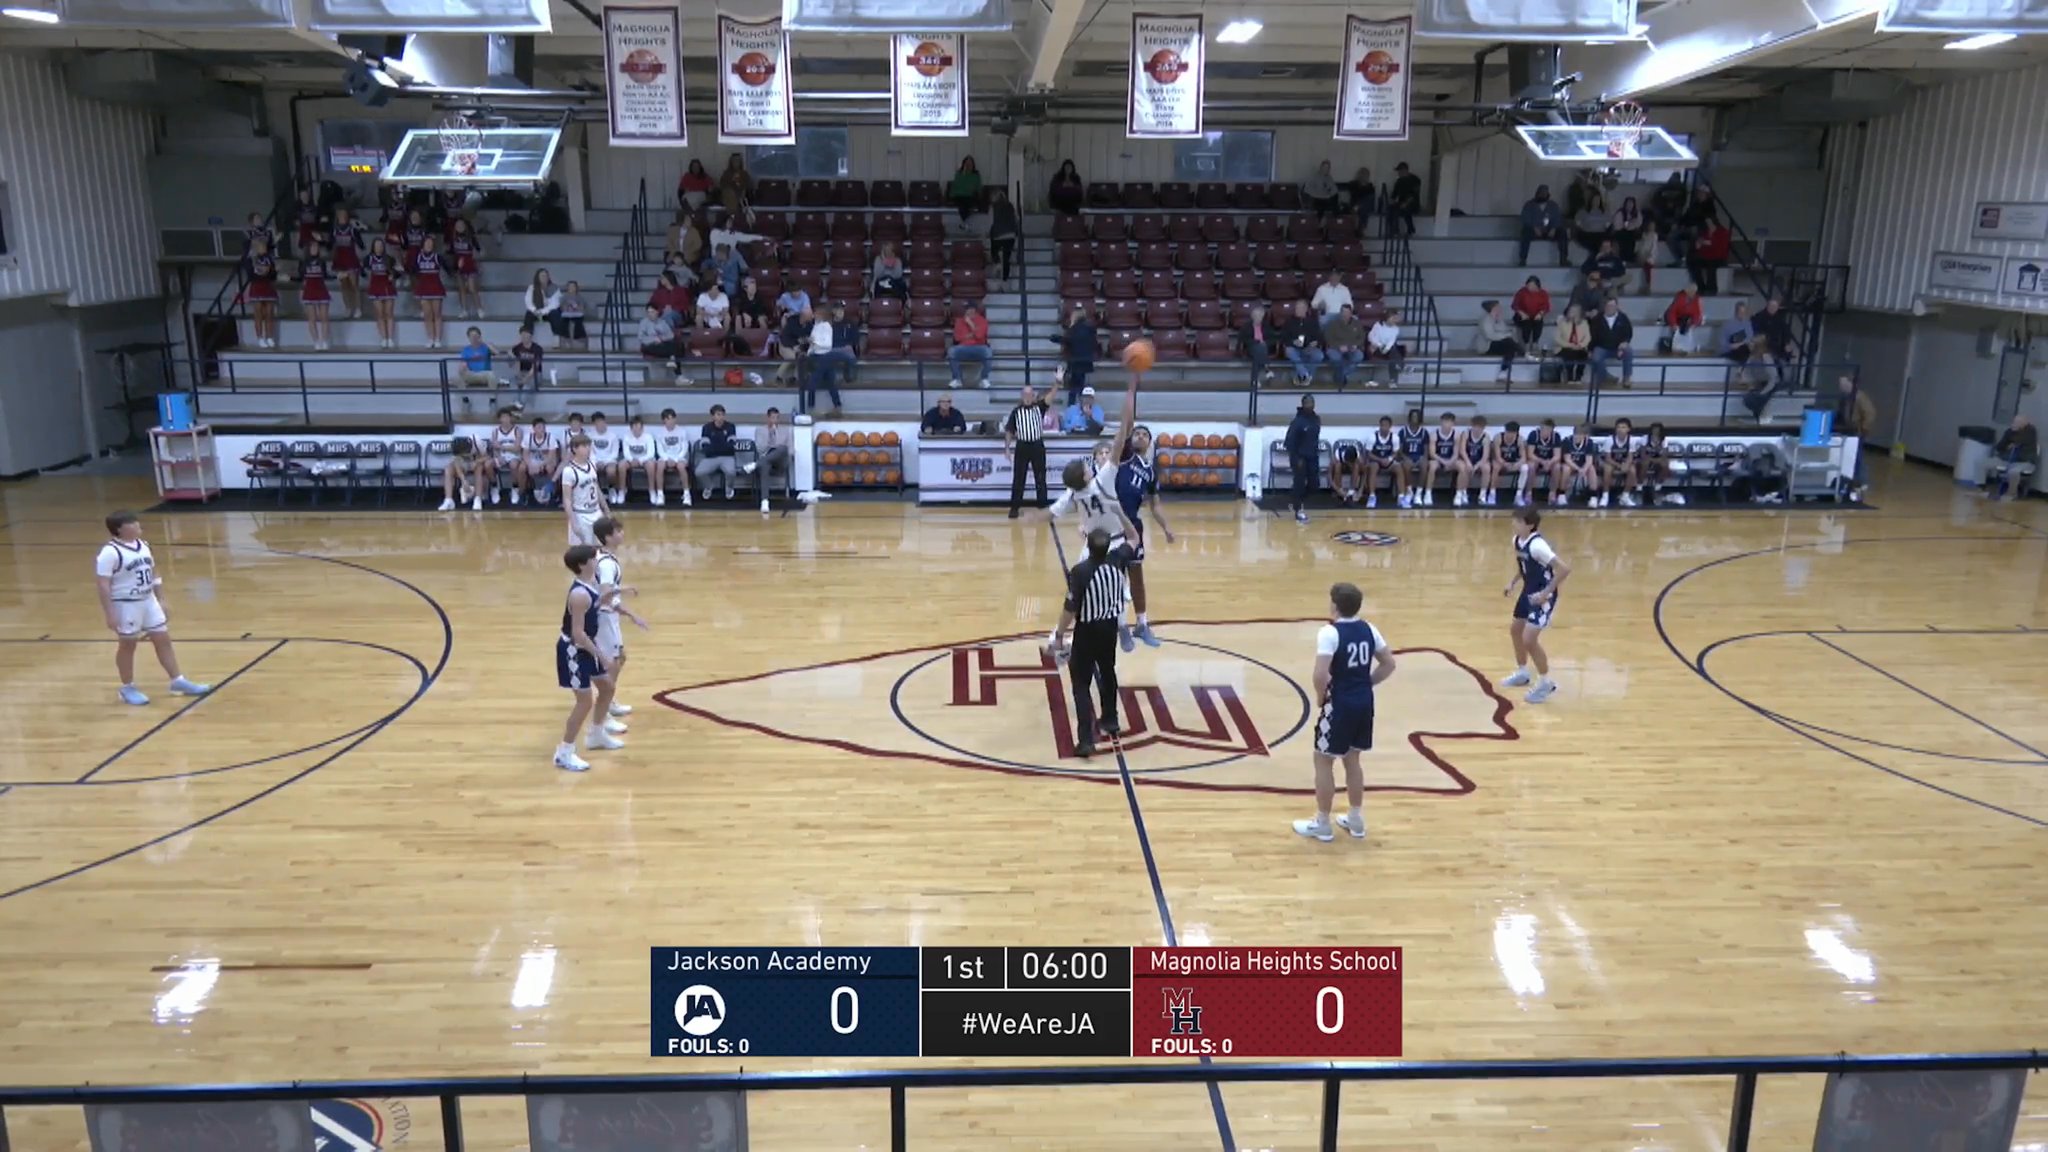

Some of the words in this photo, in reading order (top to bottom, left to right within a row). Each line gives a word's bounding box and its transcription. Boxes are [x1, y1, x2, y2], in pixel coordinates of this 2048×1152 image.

[612, 24, 670, 33] MAGNOLIA
[726, 23, 780, 39] MAGNOLIA
[1140, 23, 1194, 33] MAGNOLIA
[1353, 25, 1404, 38] MAGNOLIA
[618, 38, 667, 46] HEIGHTS
[731, 40, 776, 49] HEIGHTS
[1144, 36, 1190, 45] HEIGHTS
[1356, 39, 1400, 48] HEIGHTS
[950, 457, 993, 475] MHS
[1131, 473, 1143, 489] 11
[590, 486, 596, 500] 2
[1081, 494, 1105, 518] 14
[135, 568, 152, 587] 30
[1347, 641, 1369, 668] 20
